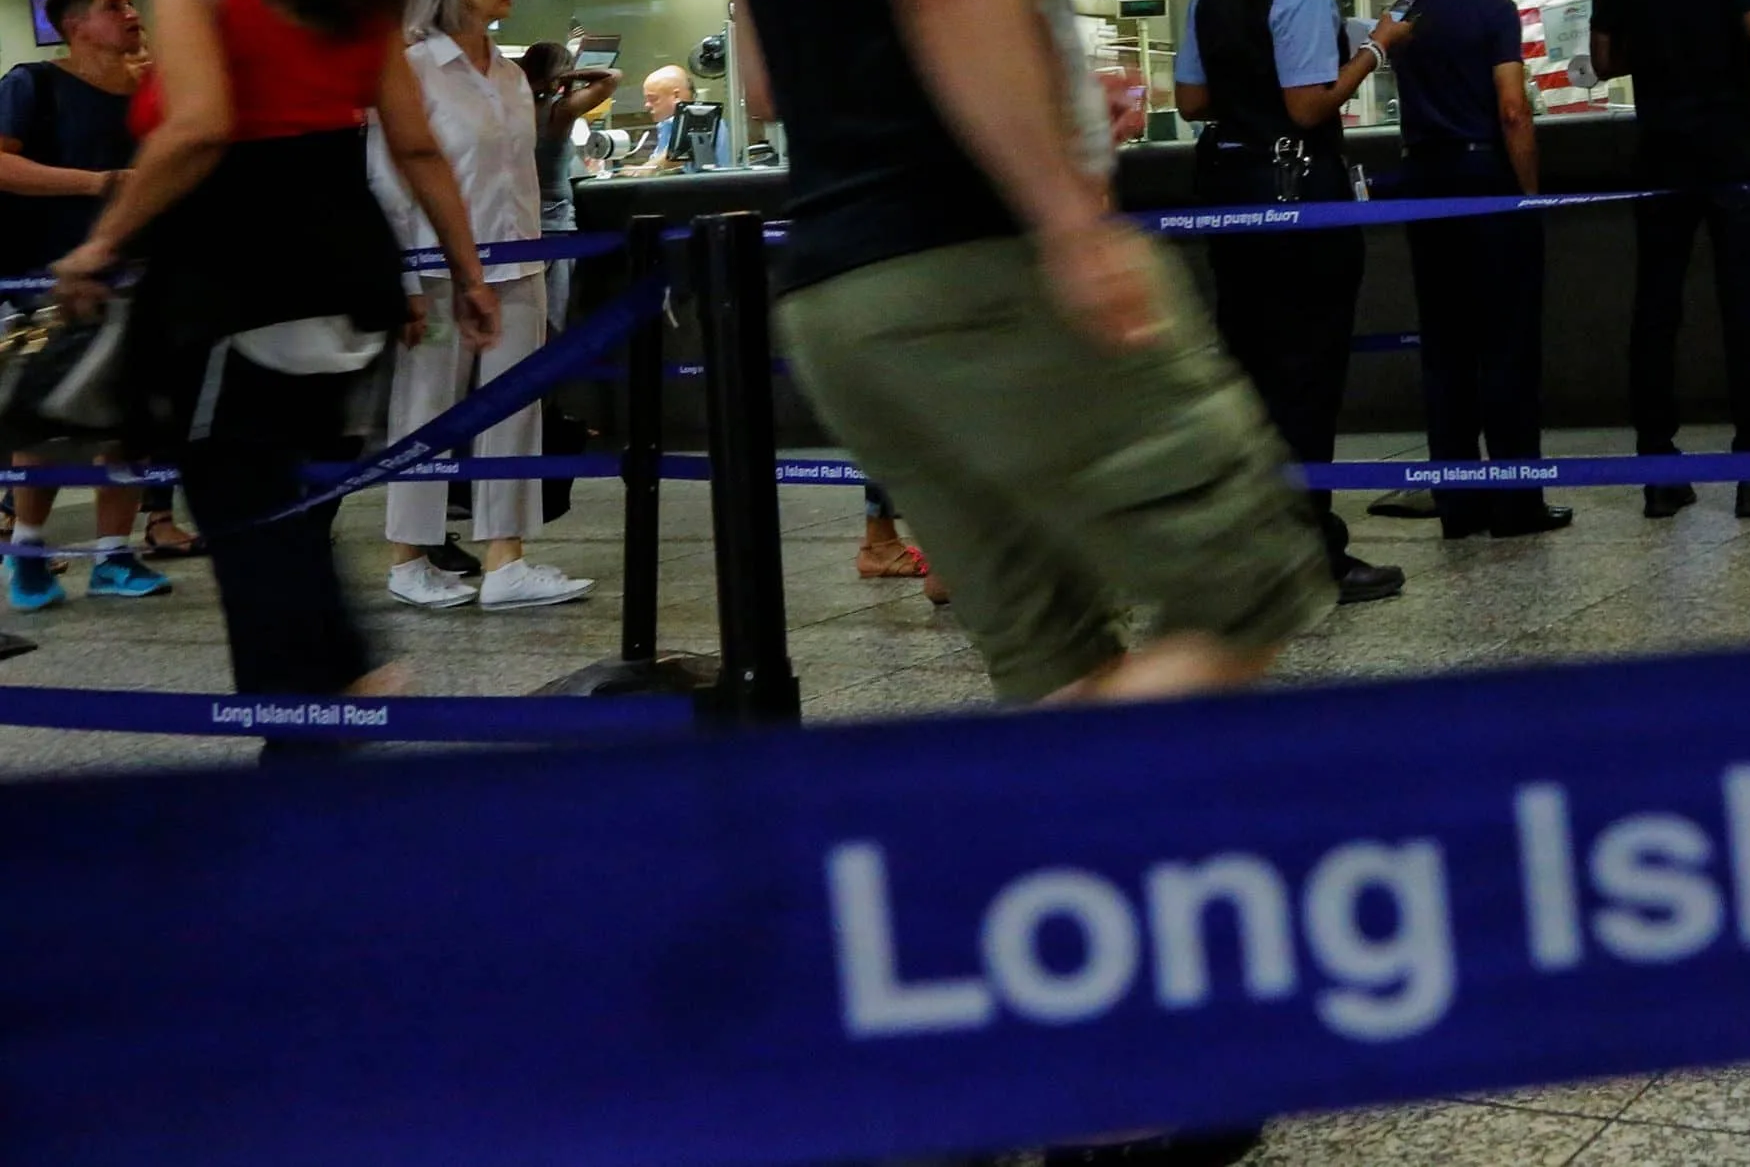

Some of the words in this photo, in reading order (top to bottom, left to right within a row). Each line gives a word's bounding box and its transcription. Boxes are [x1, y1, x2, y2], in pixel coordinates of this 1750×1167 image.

[844, 466, 866, 479] Roa
[1405, 468, 1441, 484] Long
[1443, 467, 1486, 480] Island
[1489, 466, 1517, 480] Rail
[1520, 465, 1558, 480] Road
[212, 702, 253, 727] Long
[255, 703, 305, 724] Island
[308, 704, 340, 725] Rail
[343, 705, 388, 726] Road
[828, 843, 1456, 1041] Long
